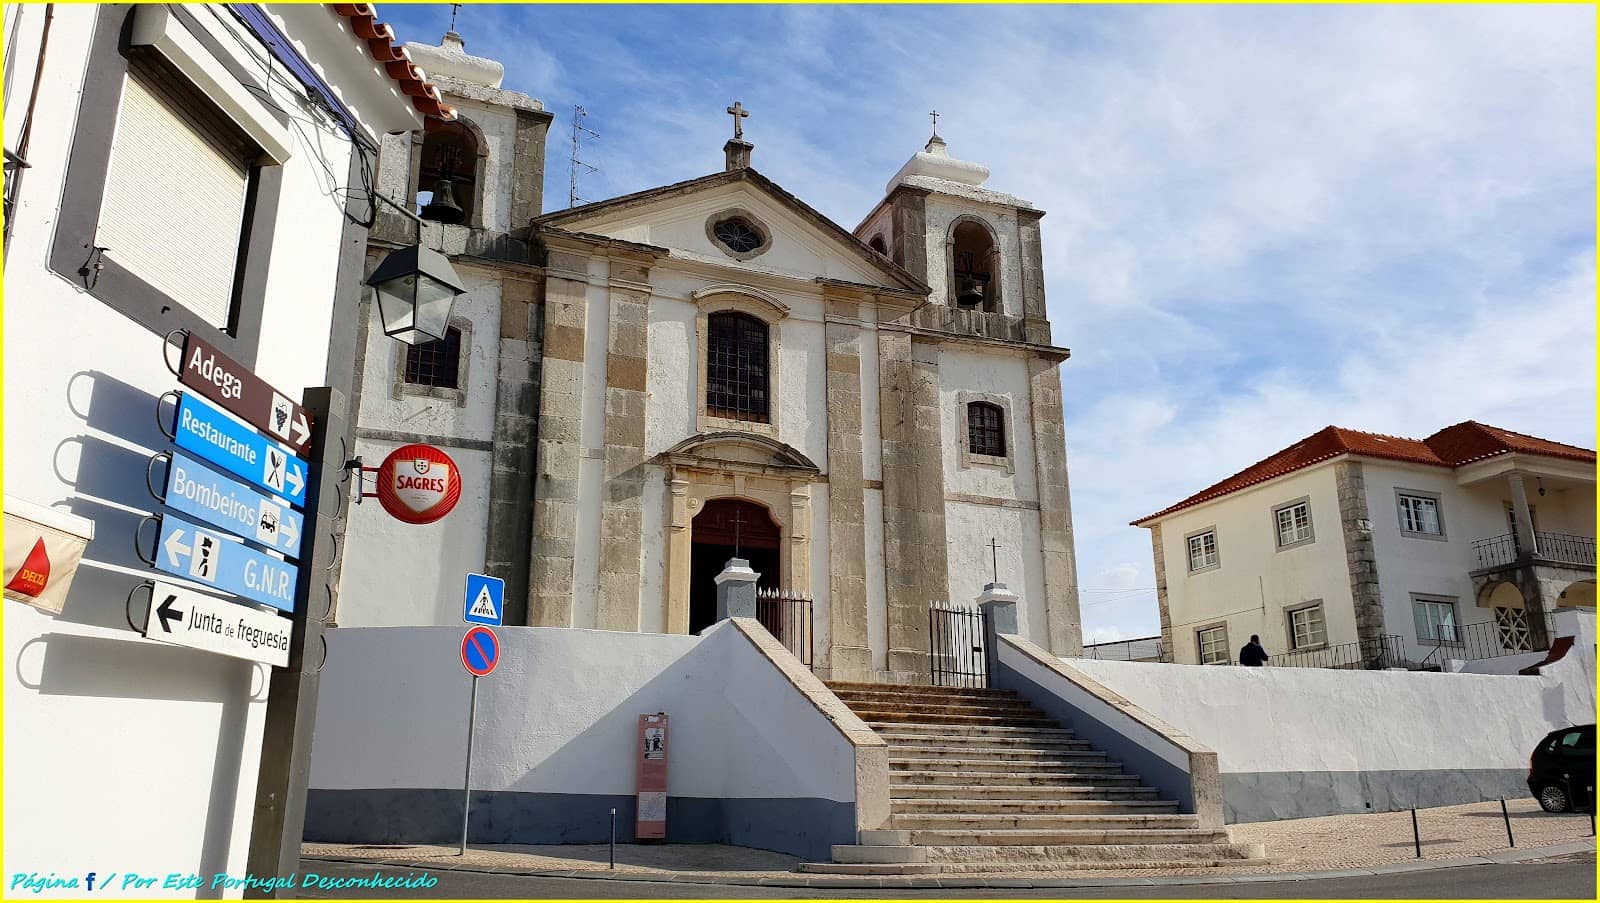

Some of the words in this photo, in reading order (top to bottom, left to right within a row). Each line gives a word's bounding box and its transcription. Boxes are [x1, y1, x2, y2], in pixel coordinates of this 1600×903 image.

[189, 346, 243, 400] Adega
[181, 407, 257, 465] Restaurante
[173, 467, 256, 527] Bombeiros
[396, 474, 444, 493] SAGRES
[21, 568, 46, 586] DELTA
[244, 559, 292, 601] G.N.R.
[187, 605, 223, 635] Junta
[224, 623, 235, 638] de
[237, 618, 289, 651] freguesia
